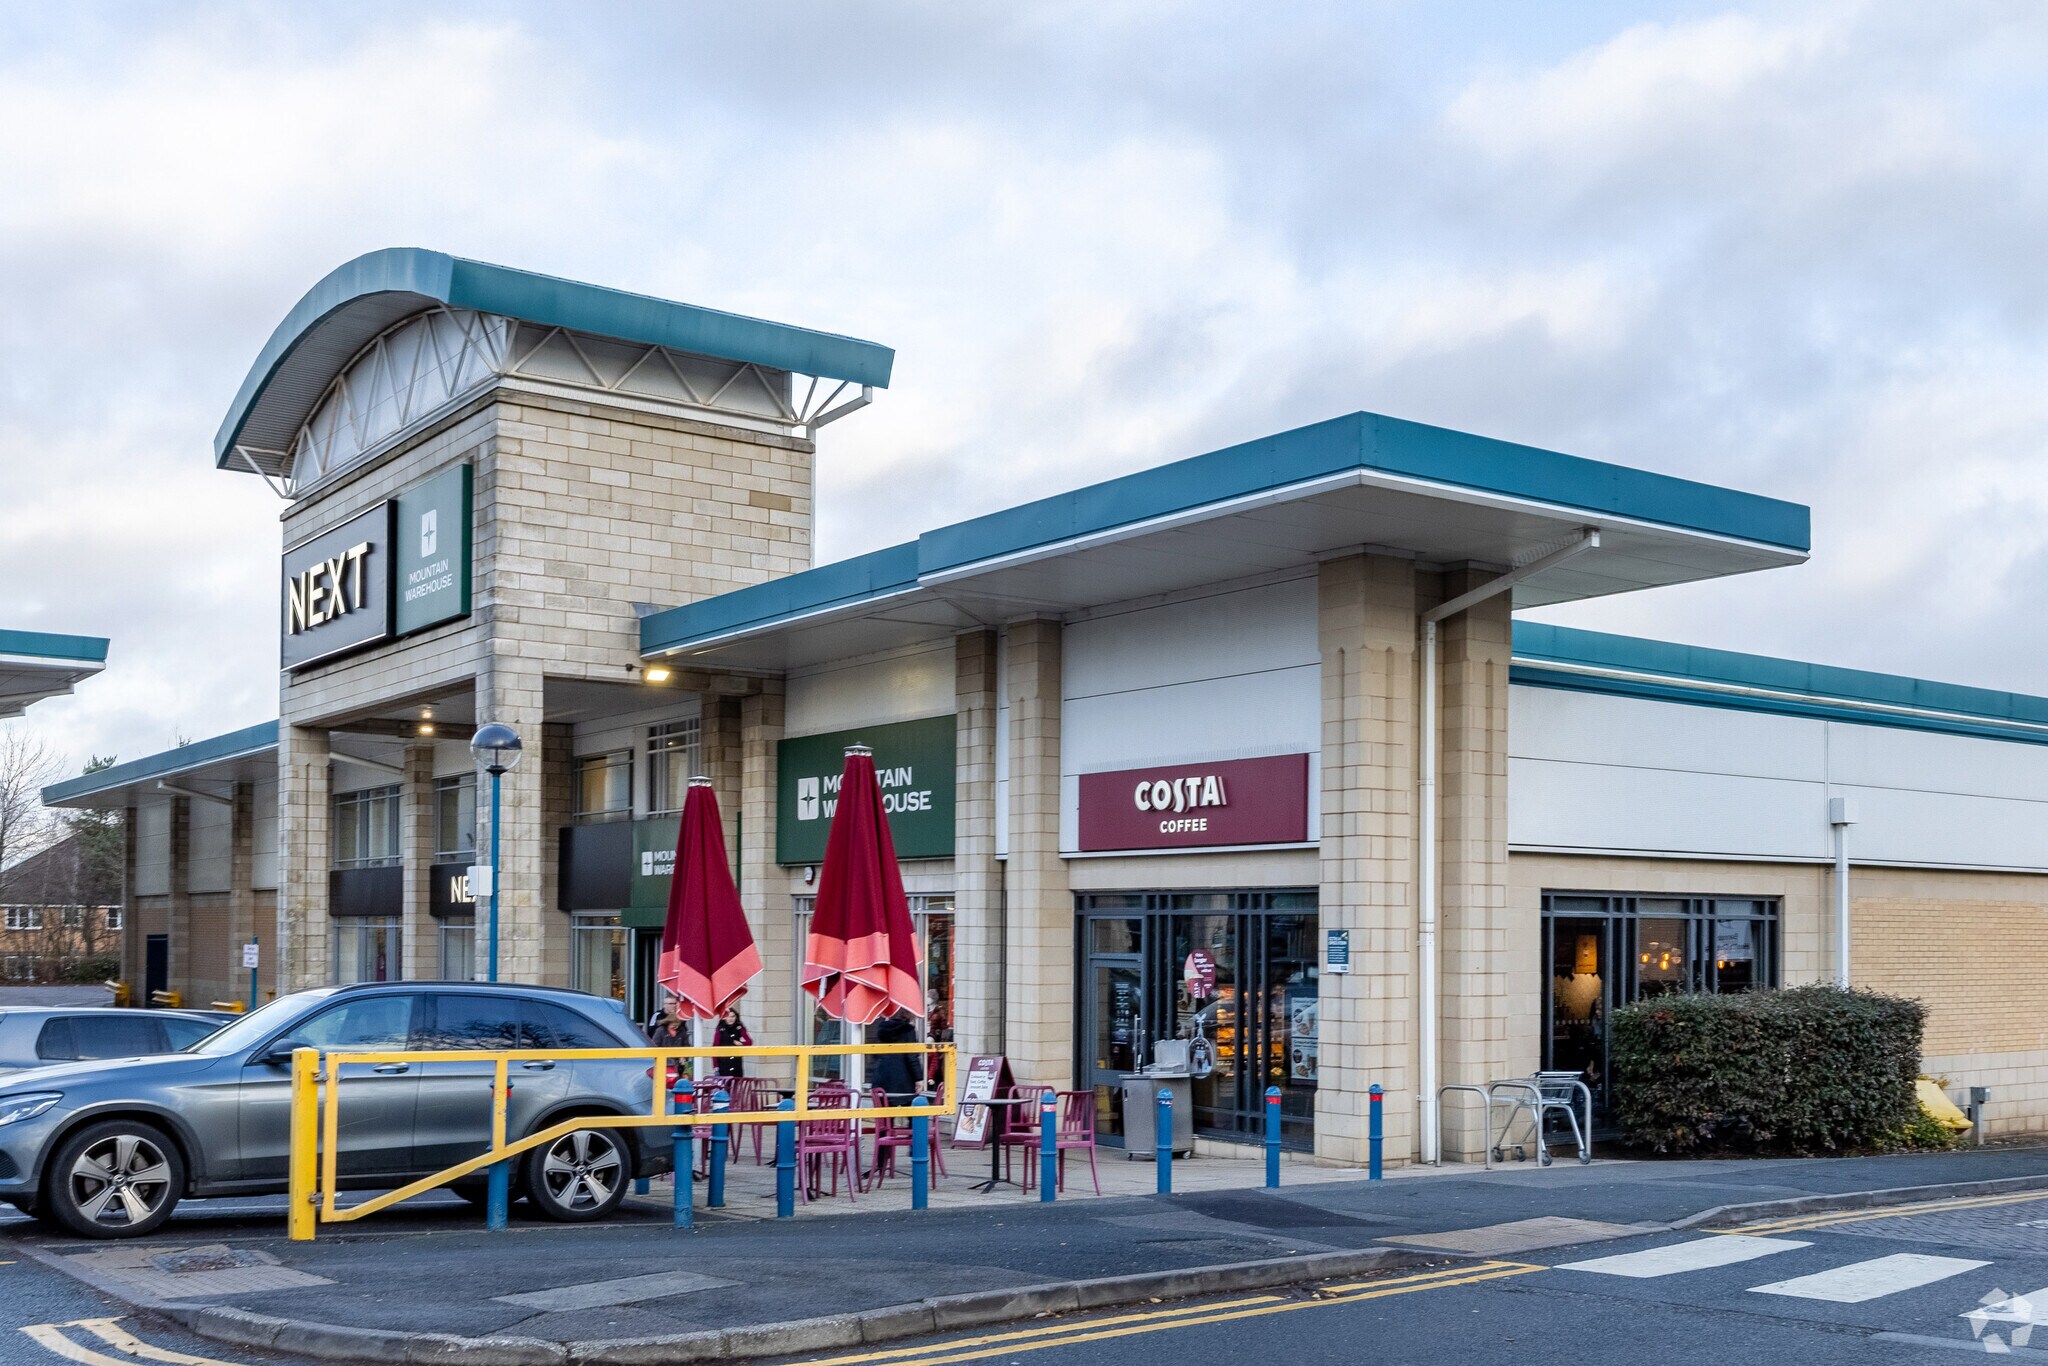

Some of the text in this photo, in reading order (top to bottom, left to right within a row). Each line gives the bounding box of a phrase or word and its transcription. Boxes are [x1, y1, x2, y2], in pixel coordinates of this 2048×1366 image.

[409, 558, 449, 586] MOUNTAIN
[288, 541, 369, 635] NEXT
[405, 573, 453, 602] WAREHOUSE
[823, 766, 912, 794] MTAIN
[1134, 775, 1227, 813] COSTA
[822, 790, 932, 819] WOUSE
[1159, 818, 1208, 834] COFFEE
[450, 875, 478, 904] NE
